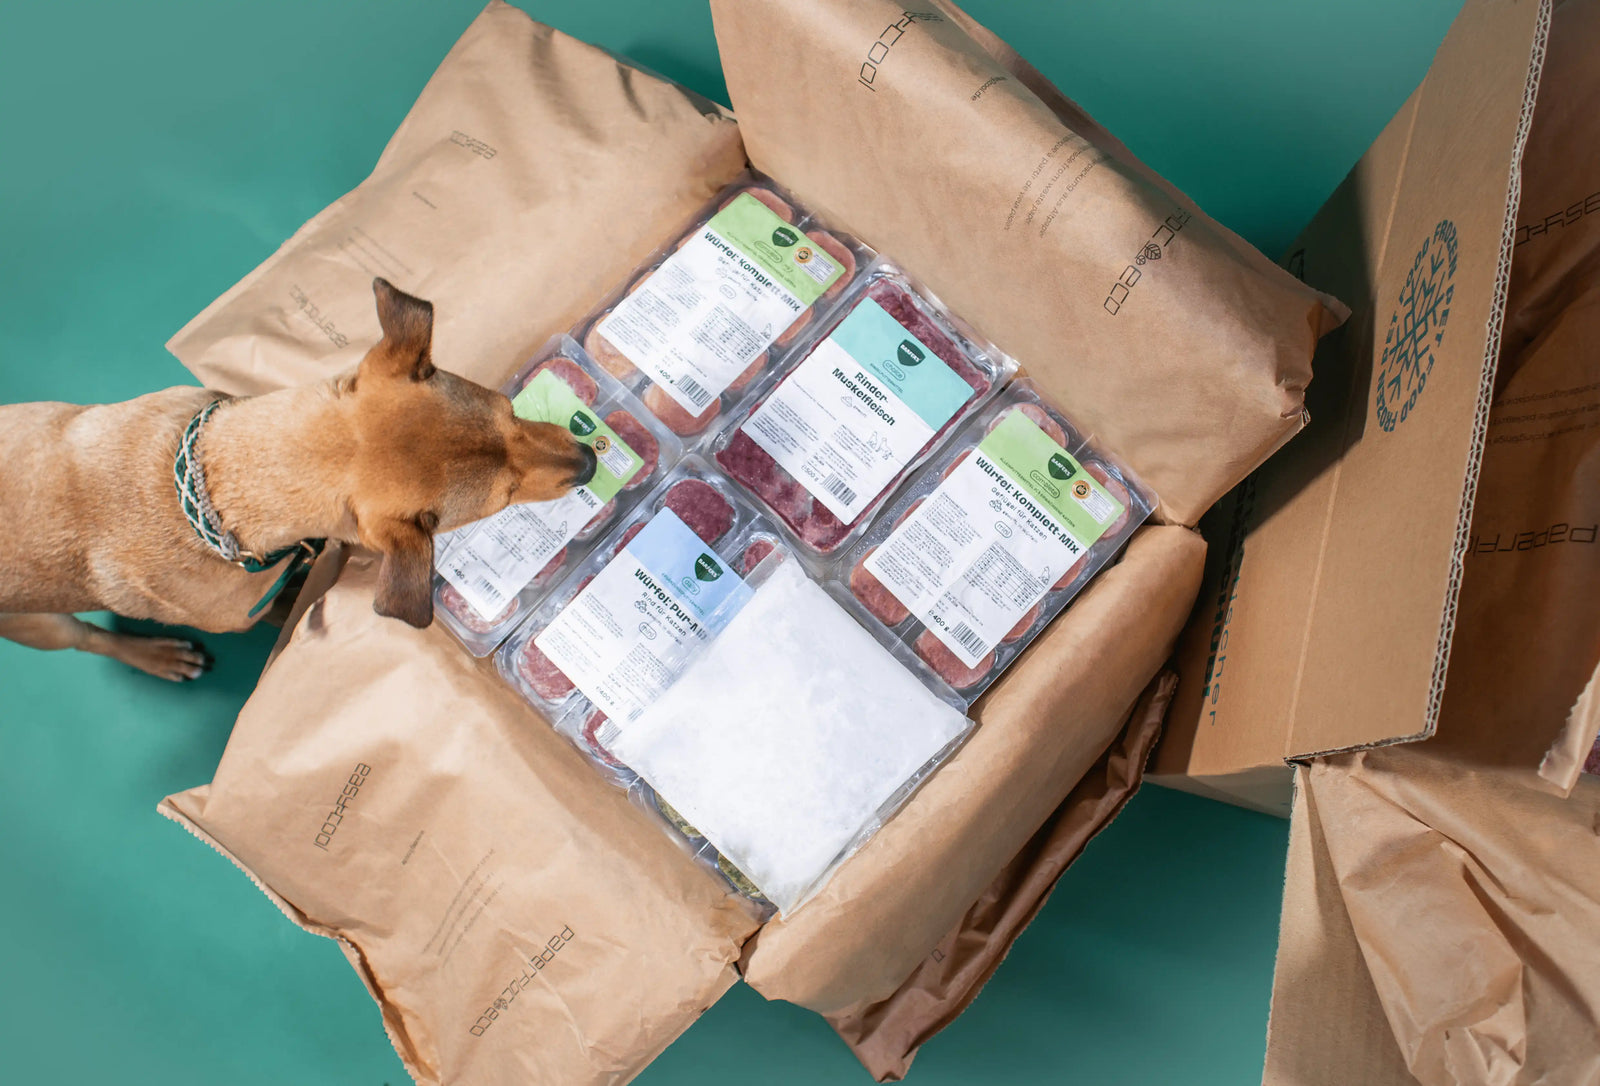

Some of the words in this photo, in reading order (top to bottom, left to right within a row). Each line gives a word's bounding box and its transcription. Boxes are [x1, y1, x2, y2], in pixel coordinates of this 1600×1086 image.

[703, 231, 740, 263] Würfel:
[736, 257, 801, 312] Komplett-Mix
[1432, 218, 1458, 280] FROZEN
[1103, 265, 1142, 316] eco
[831, 367, 897, 427] Muskelfleisch
[853, 371, 890, 405] Rinder-
[974, 456, 1015, 495] Würfel:
[1010, 489, 1081, 555] Komplett-Mix
[1015, 508, 1027, 520] für
[1025, 518, 1048, 540] Katzen
[633, 567, 672, 606] Würfel:
[641, 591, 657, 607] Rind
[654, 604, 666, 616] für
[664, 613, 688, 637] Katzen
[931, 613, 945, 627] 400
[468, 1005, 500, 1040] eco
